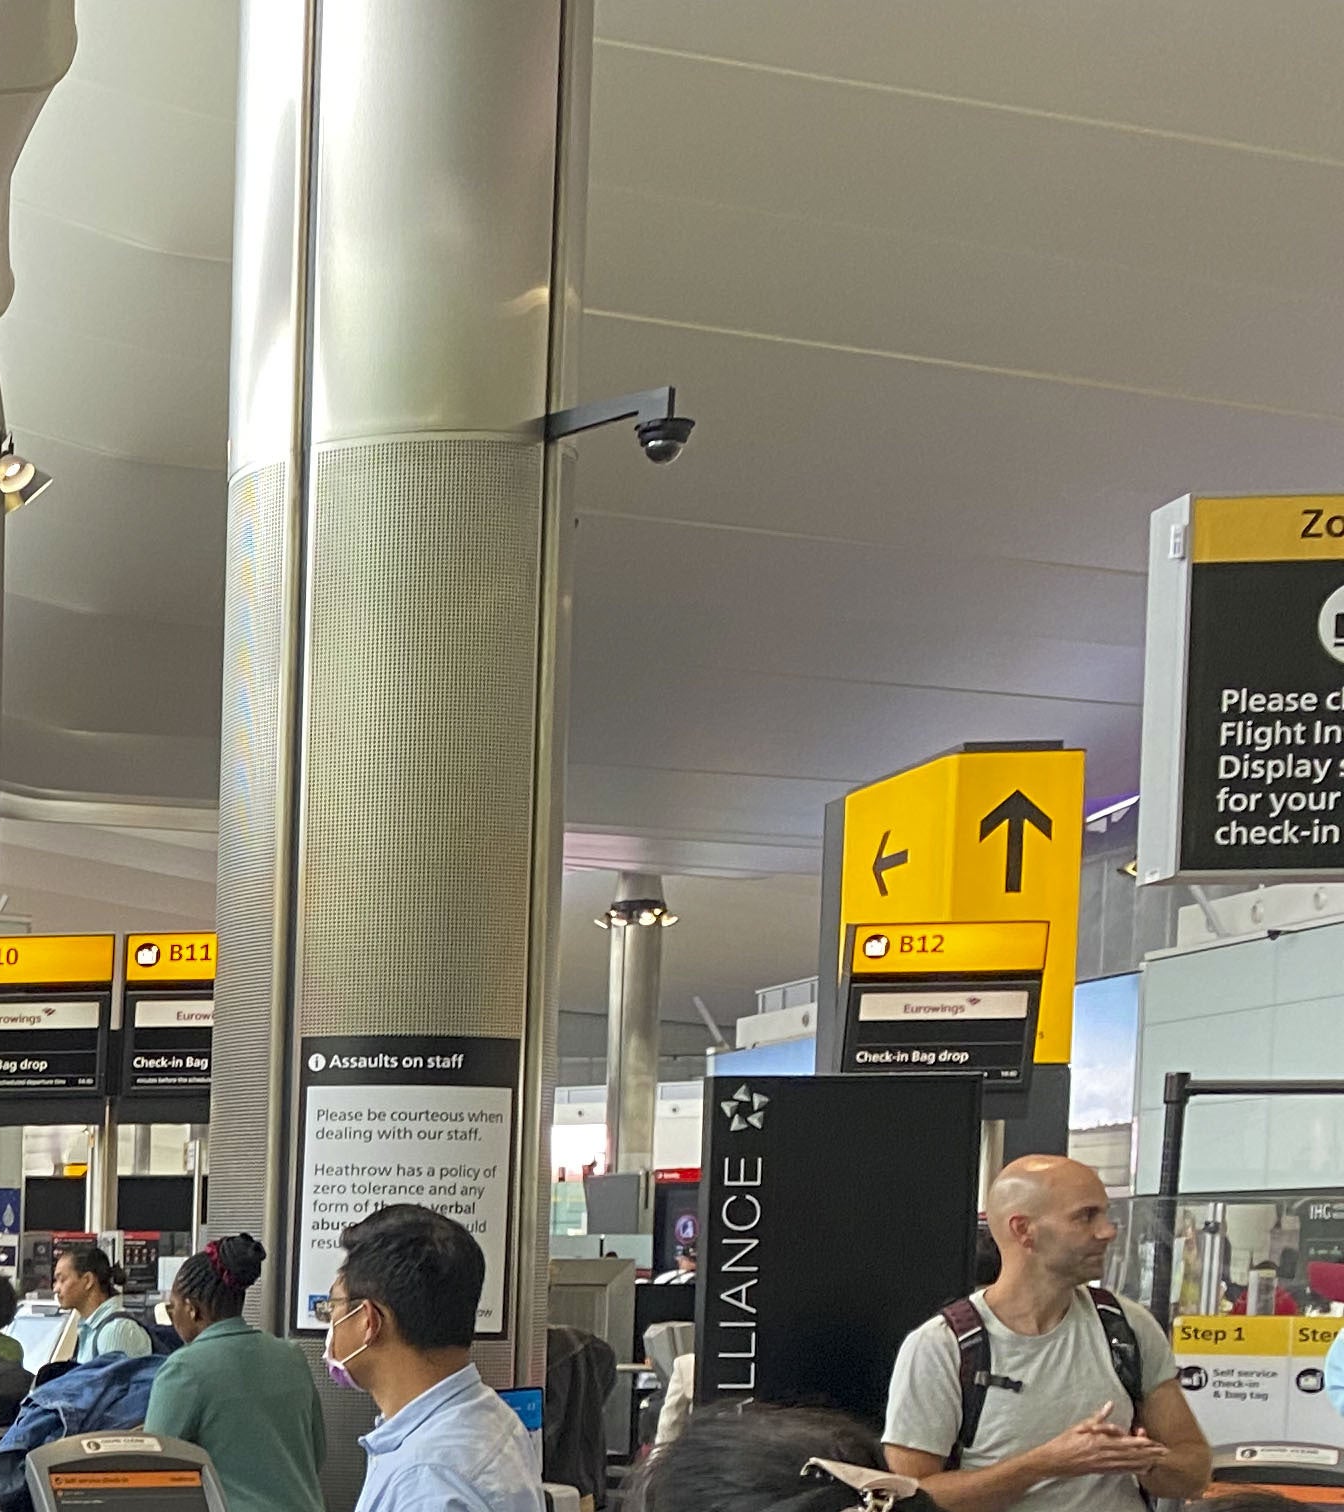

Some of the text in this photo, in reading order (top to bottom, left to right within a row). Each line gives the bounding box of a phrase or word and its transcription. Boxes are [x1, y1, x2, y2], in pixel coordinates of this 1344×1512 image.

[1220, 688, 1318, 713] Please
[1220, 721, 1306, 752] Flight
[1218, 754, 1333, 784] Display
[1216, 788, 1341, 818] for your
[1214, 820, 1340, 846] check-in
[899, 934, 945, 954] B12
[169, 943, 212, 962] B11
[176, 1011, 214, 1021] Eurow
[903, 1003, 966, 1017] Eurowings
[19, 1058, 48, 1072] drop
[133, 1056, 209, 1071] Check-in Bag
[329, 1053, 465, 1069] Assaults on staff
[855, 1050, 969, 1065] Check-in Bag drop
[316, 1108, 504, 1124] Please be courteous when
[315, 1126, 483, 1143] dealing with our staff.
[314, 1163, 498, 1181] Heathrow has a policy of
[312, 1183, 486, 1200] zero tolerance and any
[312, 1200, 349, 1213] form
[353, 1199, 370, 1213] of
[430, 1202, 476, 1215] verbal
[1181, 1326, 1245, 1344] Step 1
[1213, 1368, 1278, 1379] Self service
[1212, 1380, 1260, 1389] check-in
[1213, 1391, 1269, 1402] & bag tag
